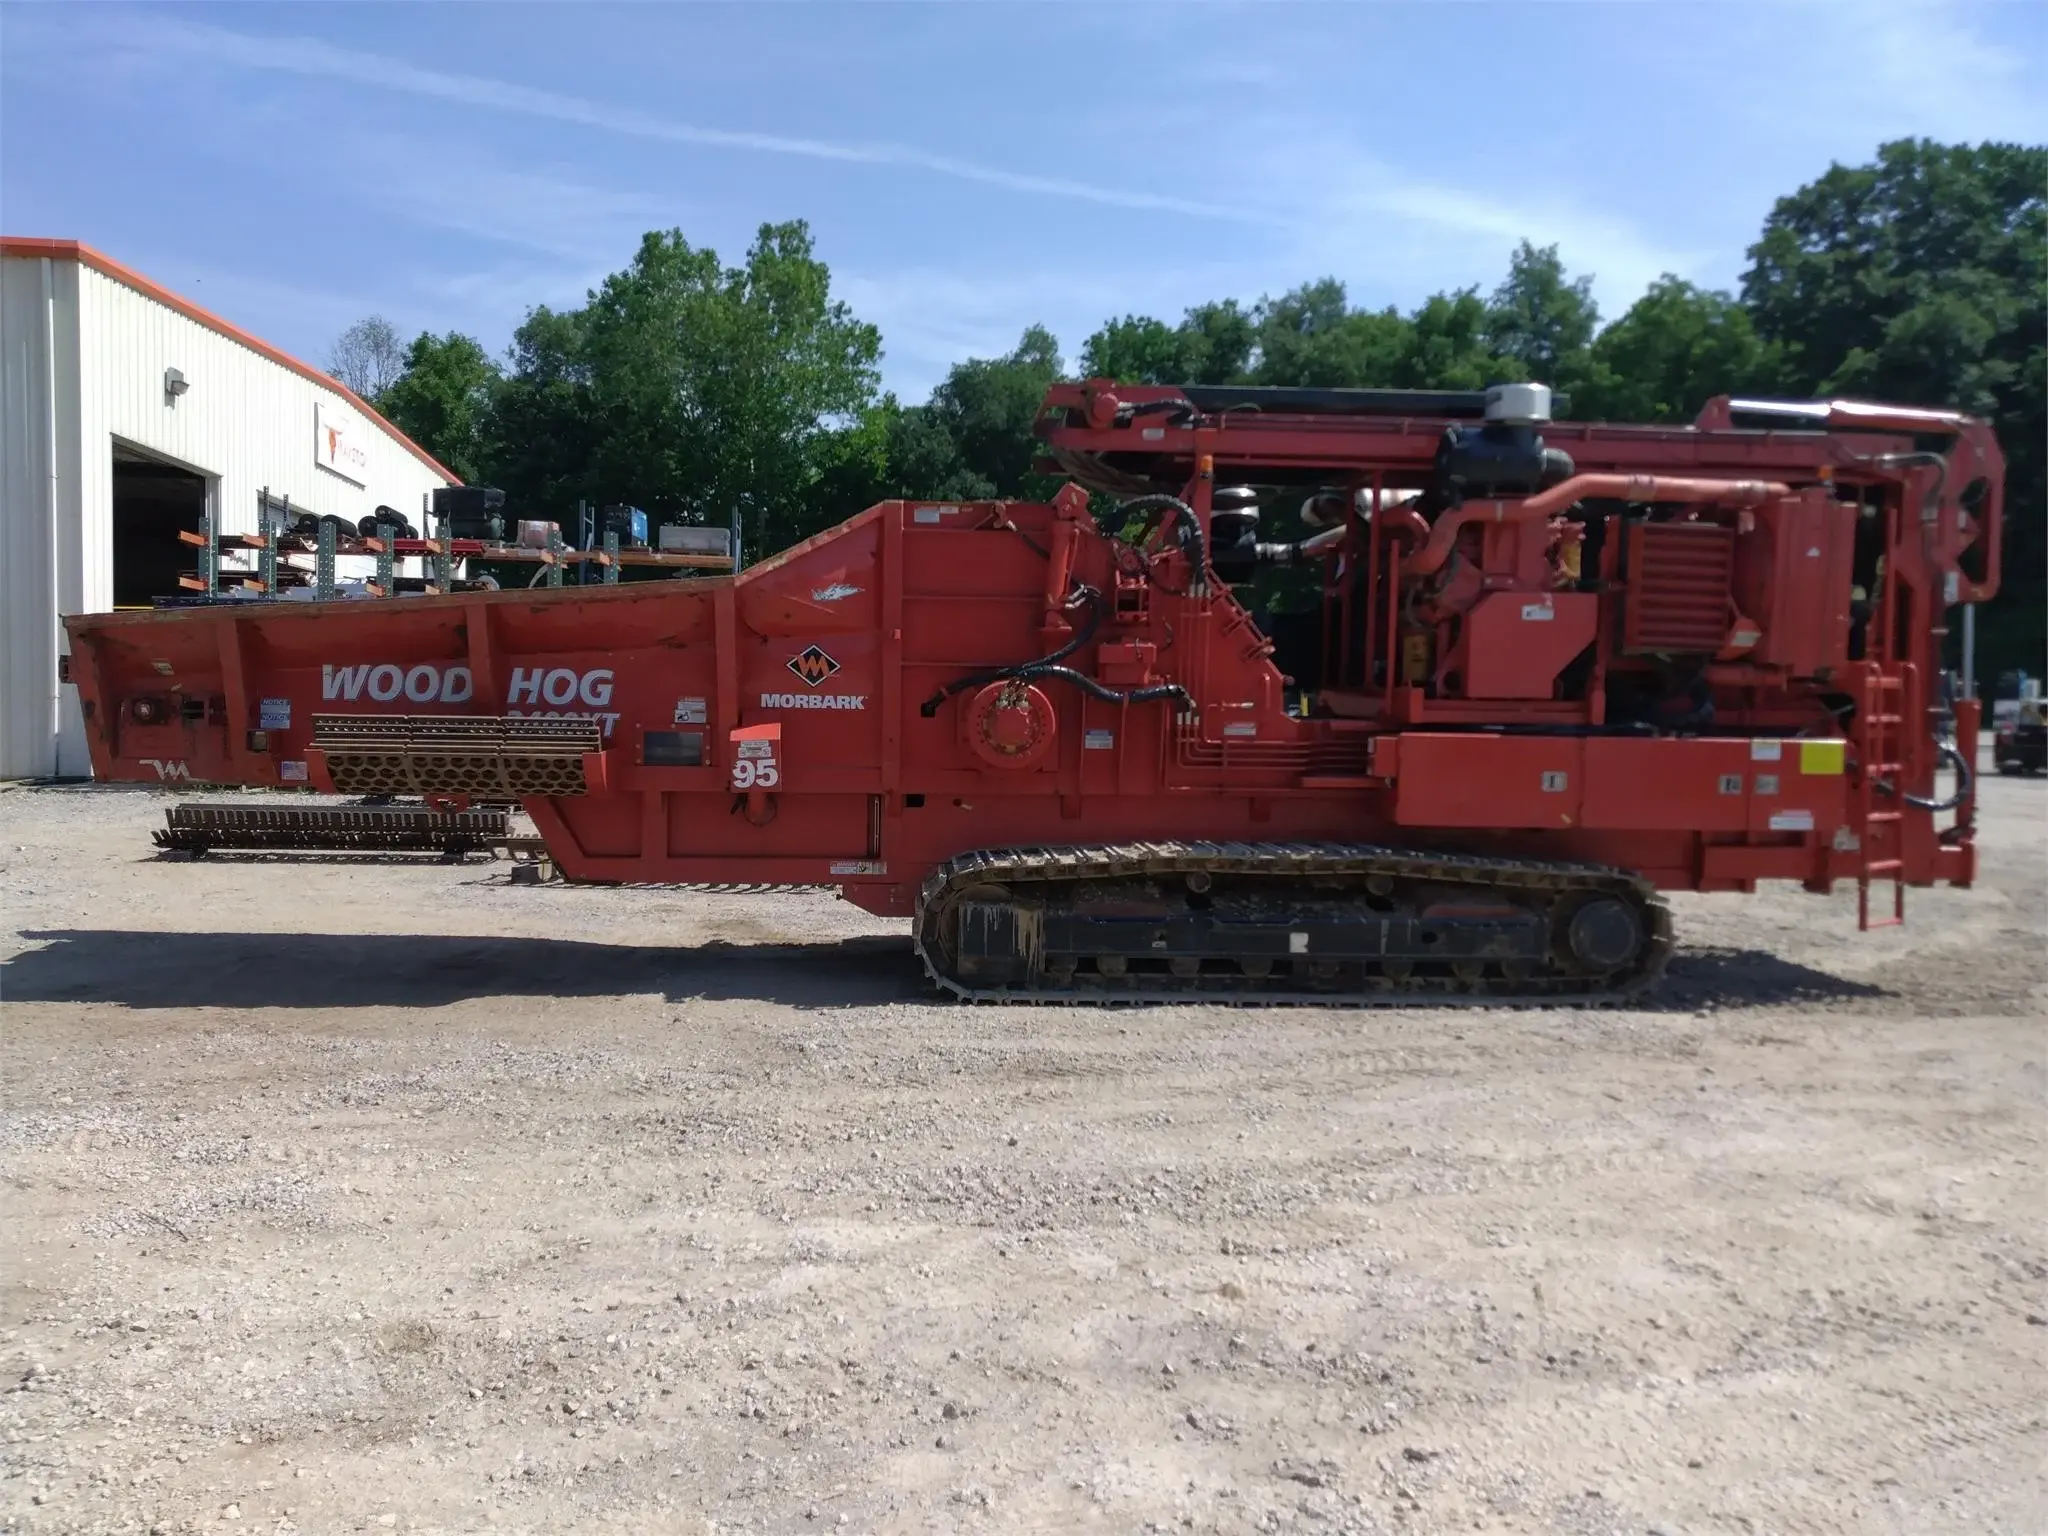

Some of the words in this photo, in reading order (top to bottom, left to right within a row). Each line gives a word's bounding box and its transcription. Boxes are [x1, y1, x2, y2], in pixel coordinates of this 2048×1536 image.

[322, 664, 473, 702] WOOD
[507, 667, 615, 706] HOG
[760, 693, 865, 710] MORBARK
[732, 758, 779, 789] 95
